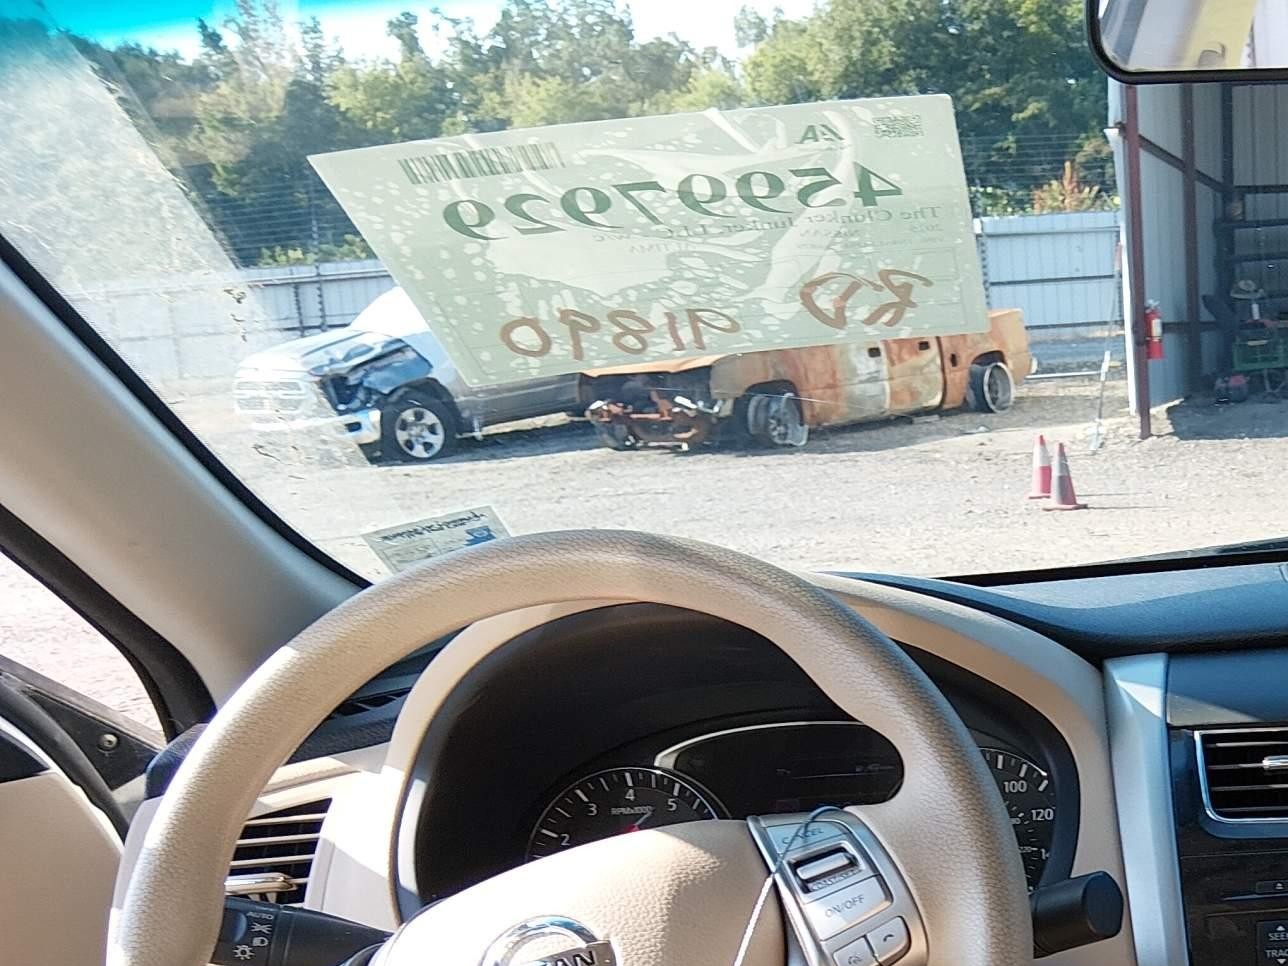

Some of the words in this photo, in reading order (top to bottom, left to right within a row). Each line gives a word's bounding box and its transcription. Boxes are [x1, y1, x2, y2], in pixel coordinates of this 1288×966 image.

[1003, 780, 1028, 793] 100
[625, 788, 636, 801] 4
[588, 803, 598, 816] 3
[667, 798, 679, 812] 5
[1031, 808, 1054, 821] 120
[560, 833, 571, 846] 2
